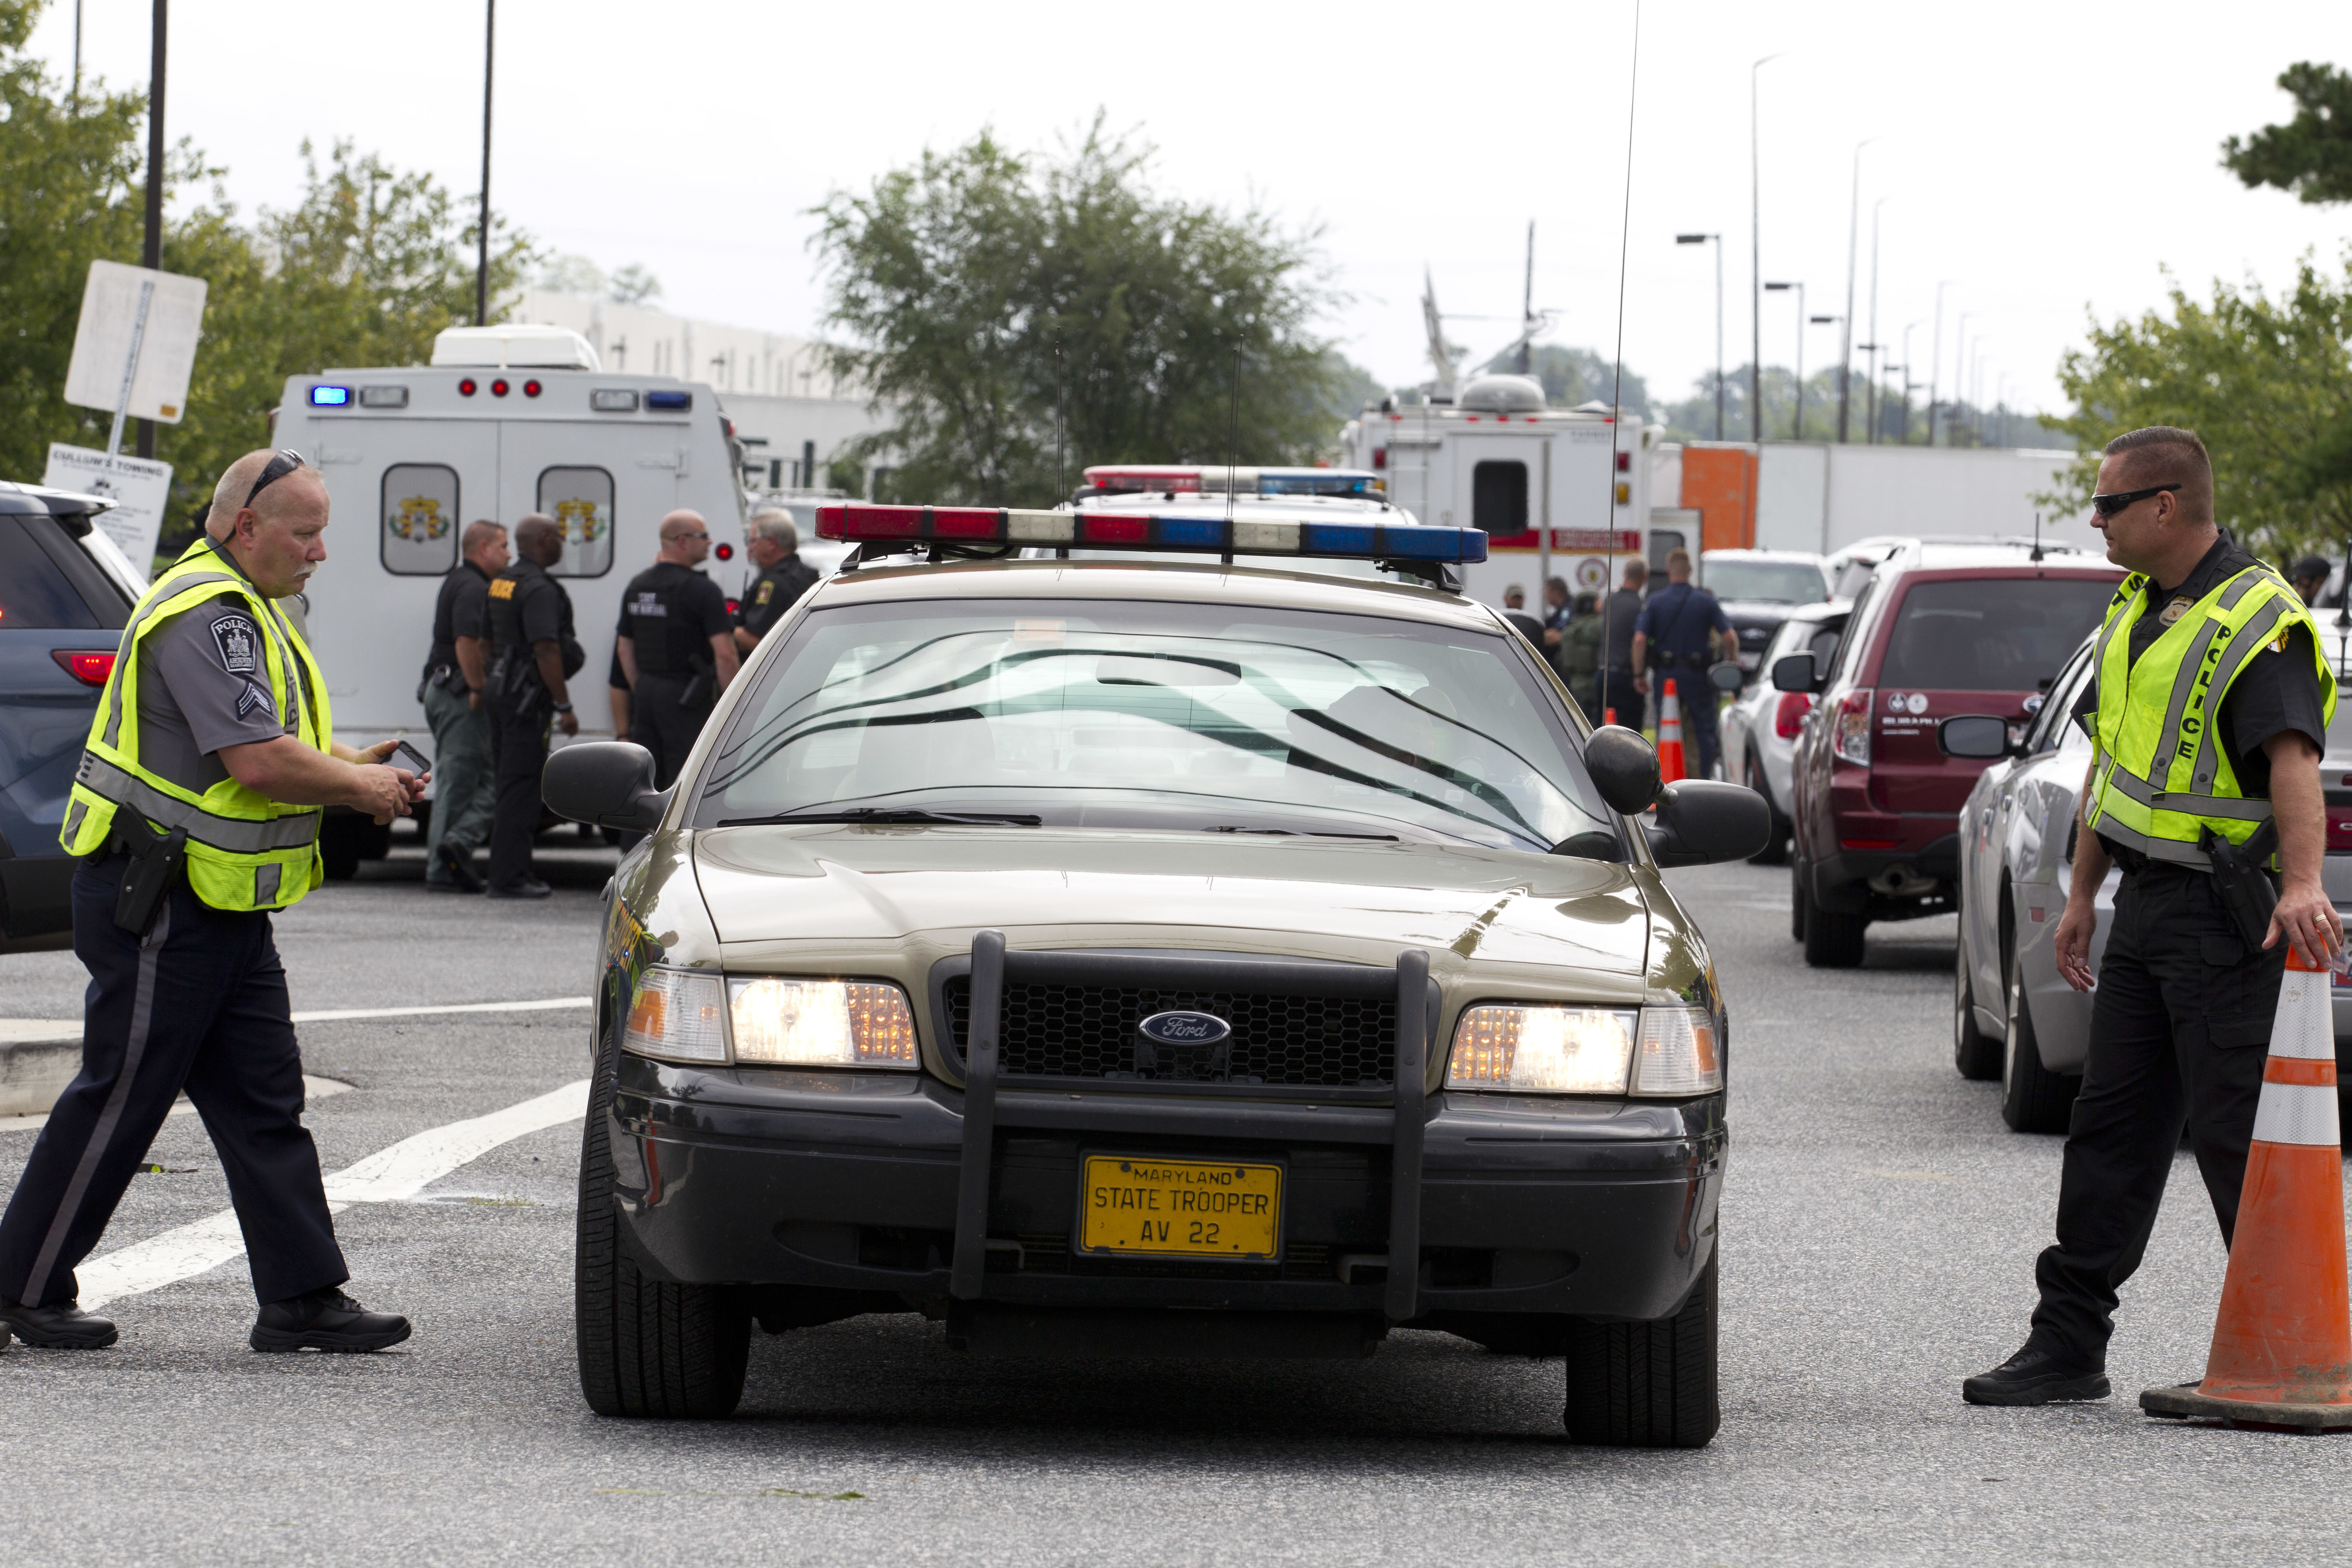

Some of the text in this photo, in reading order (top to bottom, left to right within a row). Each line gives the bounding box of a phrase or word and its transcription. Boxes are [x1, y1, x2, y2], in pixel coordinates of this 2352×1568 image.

[117, 460, 164, 476] TOWING
[215, 620, 252, 634] POLICE
[2178, 625, 2231, 759] POLICE
[1162, 1017, 1208, 1037] Ford
[1134, 1168, 1232, 1185] MARYLAND
[1095, 1187, 1269, 1214] STATE TROOPER
[1141, 1220, 1220, 1244] AV 22
